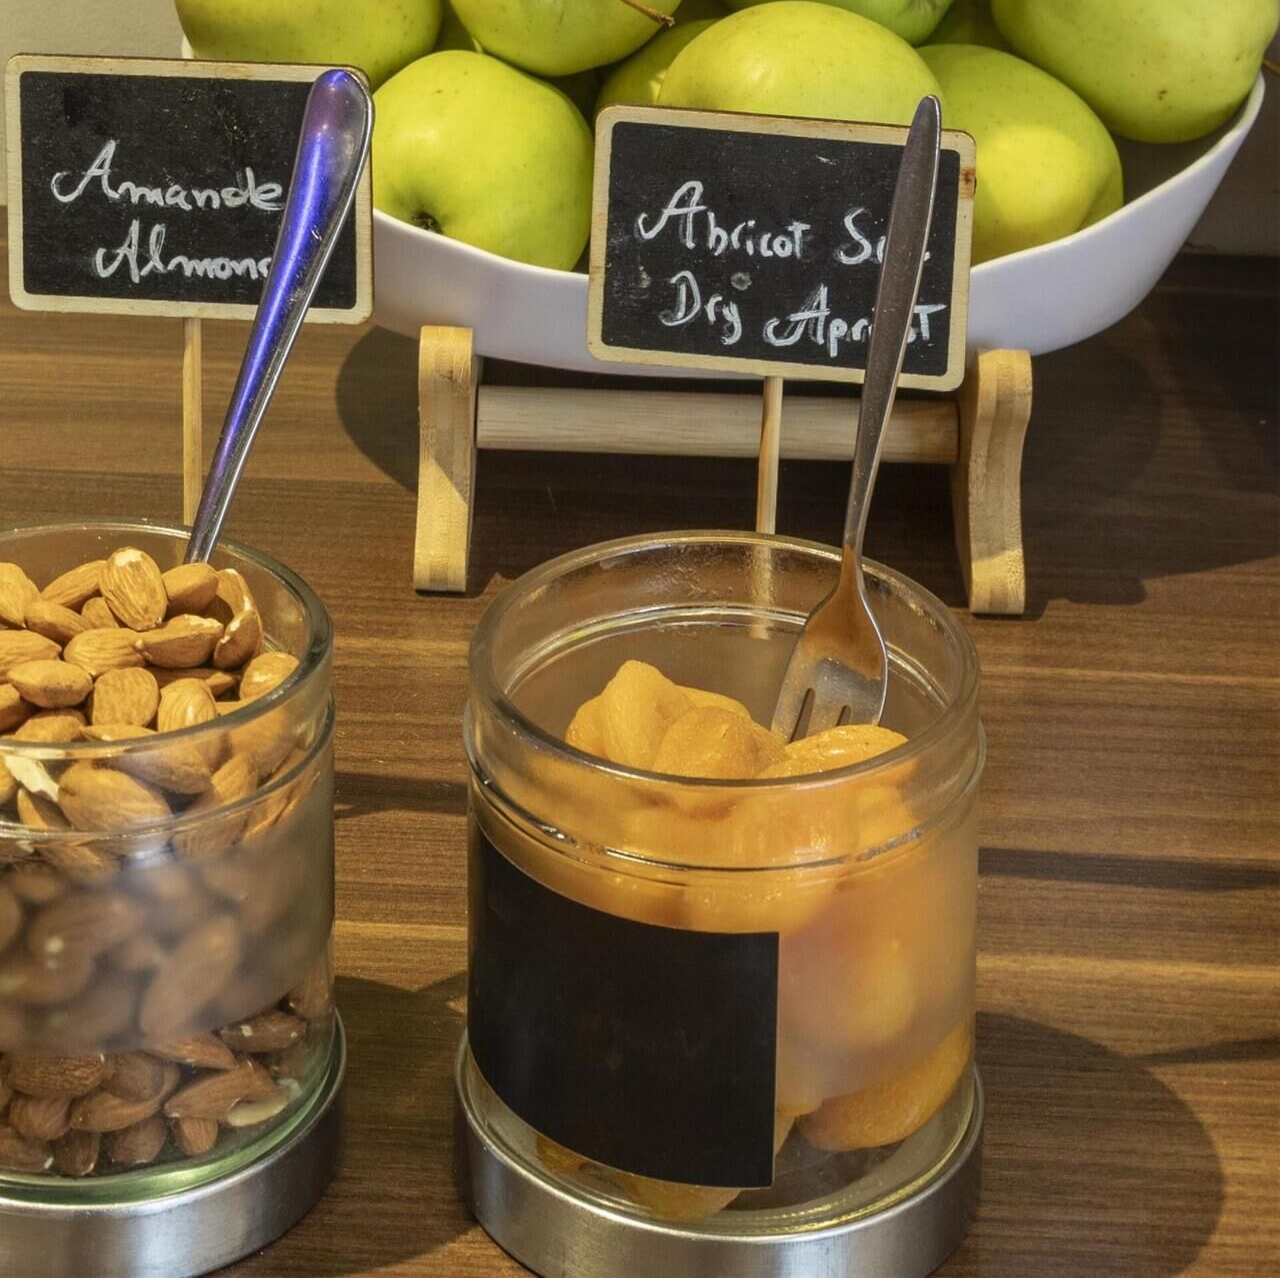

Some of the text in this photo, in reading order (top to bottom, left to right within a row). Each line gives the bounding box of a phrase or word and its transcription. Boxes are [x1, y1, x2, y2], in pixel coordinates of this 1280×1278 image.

[51, 139, 286, 211] Amande
[636, 180, 812, 260] Abricot
[659, 269, 743, 346] Dry
